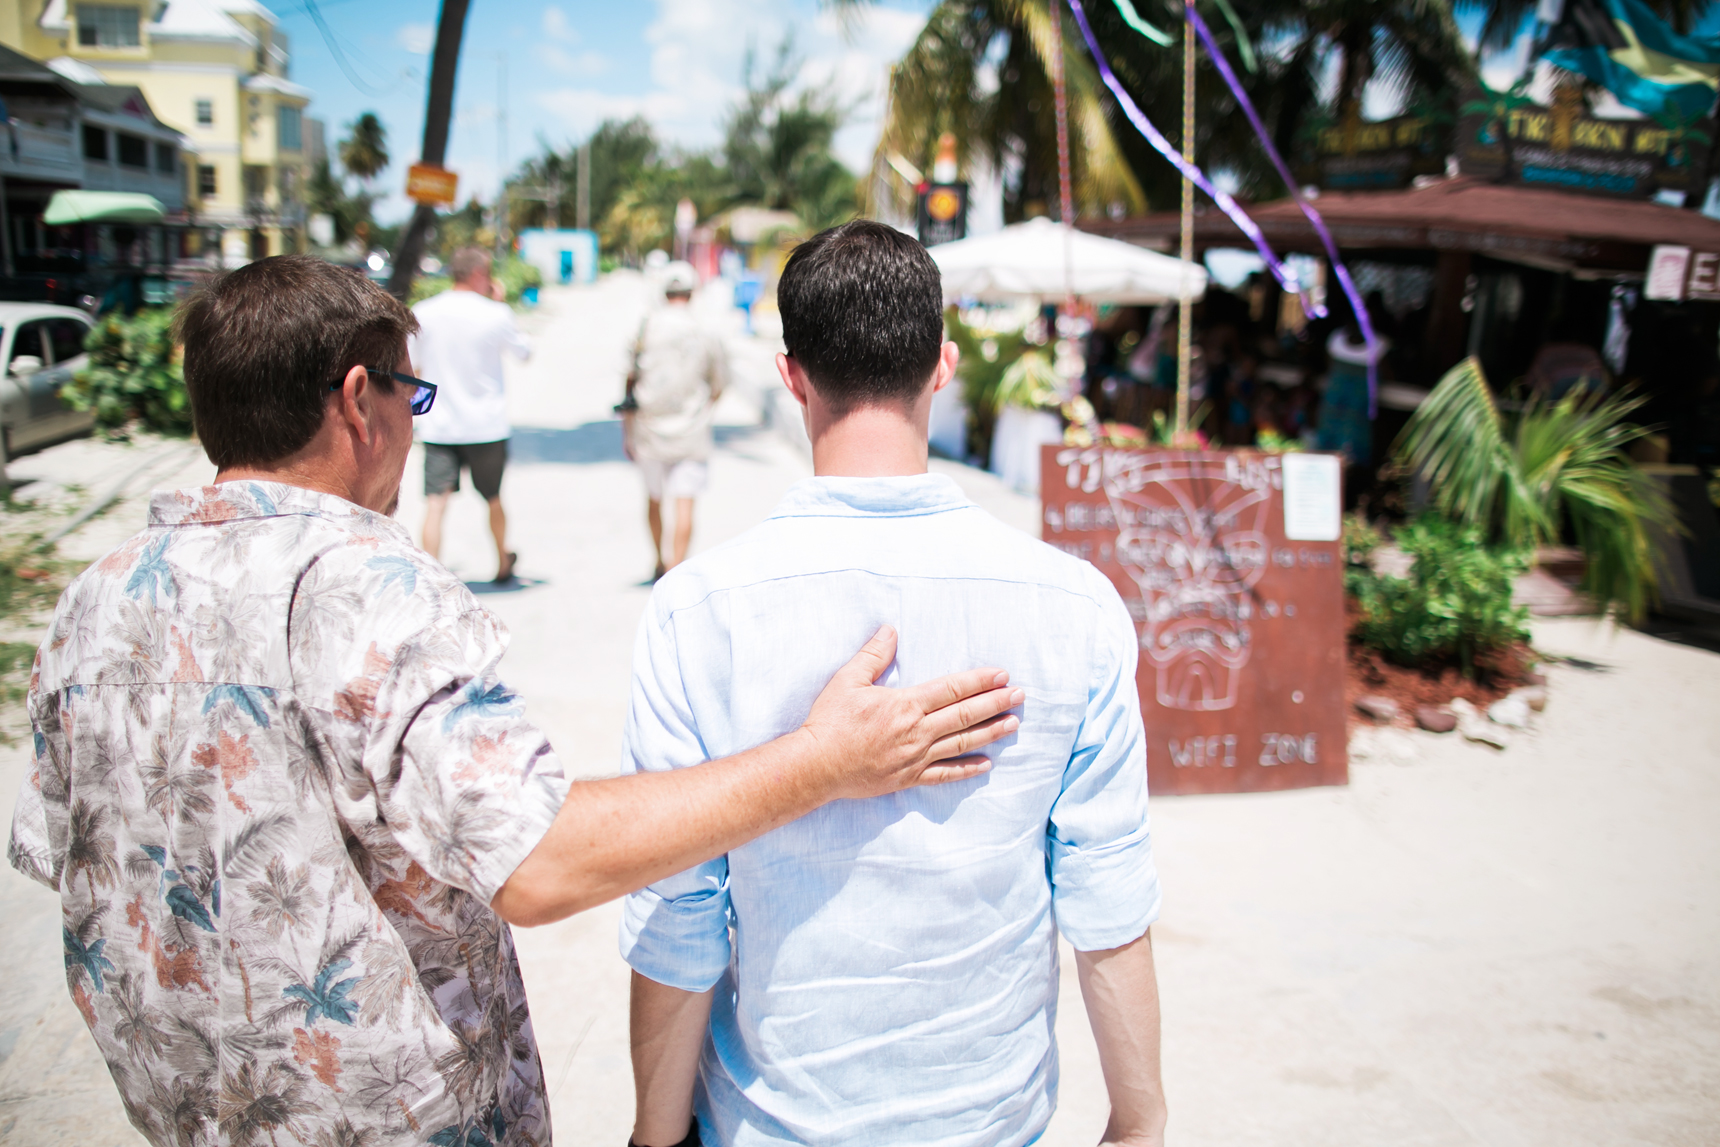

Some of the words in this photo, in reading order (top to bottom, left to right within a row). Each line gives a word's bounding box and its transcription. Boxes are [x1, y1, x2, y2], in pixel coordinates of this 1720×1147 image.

[1056, 449, 1144, 498] TIKI
[1168, 733, 1238, 769] WIFI
[1258, 731, 1319, 768] ZONE
